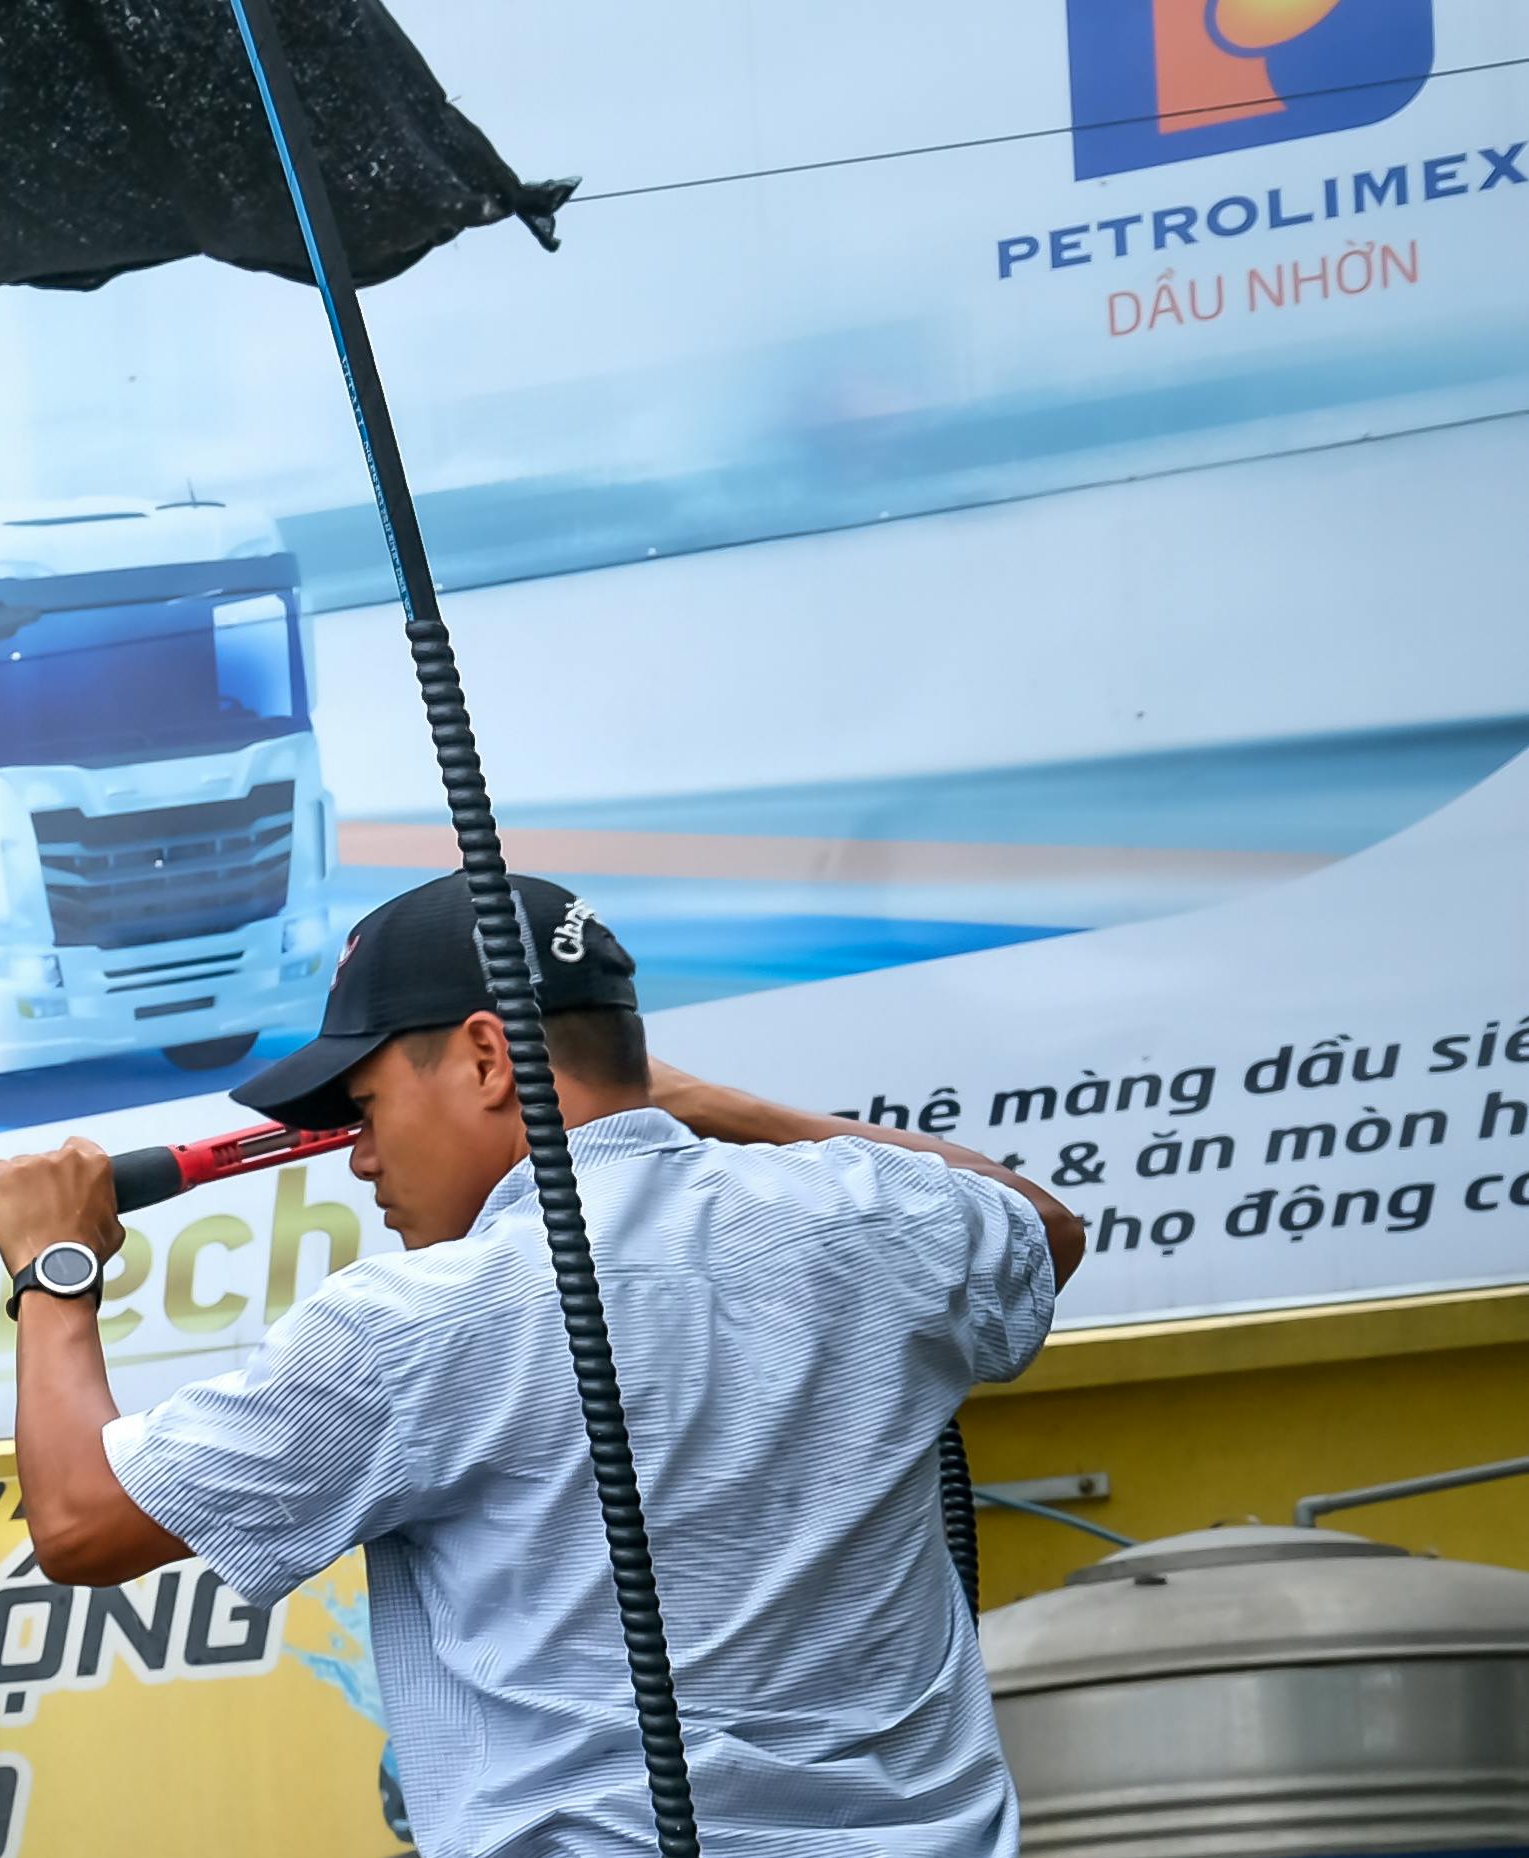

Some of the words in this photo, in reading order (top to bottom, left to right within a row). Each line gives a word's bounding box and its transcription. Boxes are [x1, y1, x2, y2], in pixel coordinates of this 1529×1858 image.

[996, 139, 1529, 281] PETROLIMEX
[1247, 239, 1421, 313] NHỜN
[988, 1066, 1216, 1127] màng
[1243, 1034, 1402, 1095] dầu
[1050, 1142, 1106, 1188] &
[1136, 1130, 1235, 1178] ăn
[1265, 1105, 1448, 1166] mòn
[1225, 1184, 1436, 1243] động
